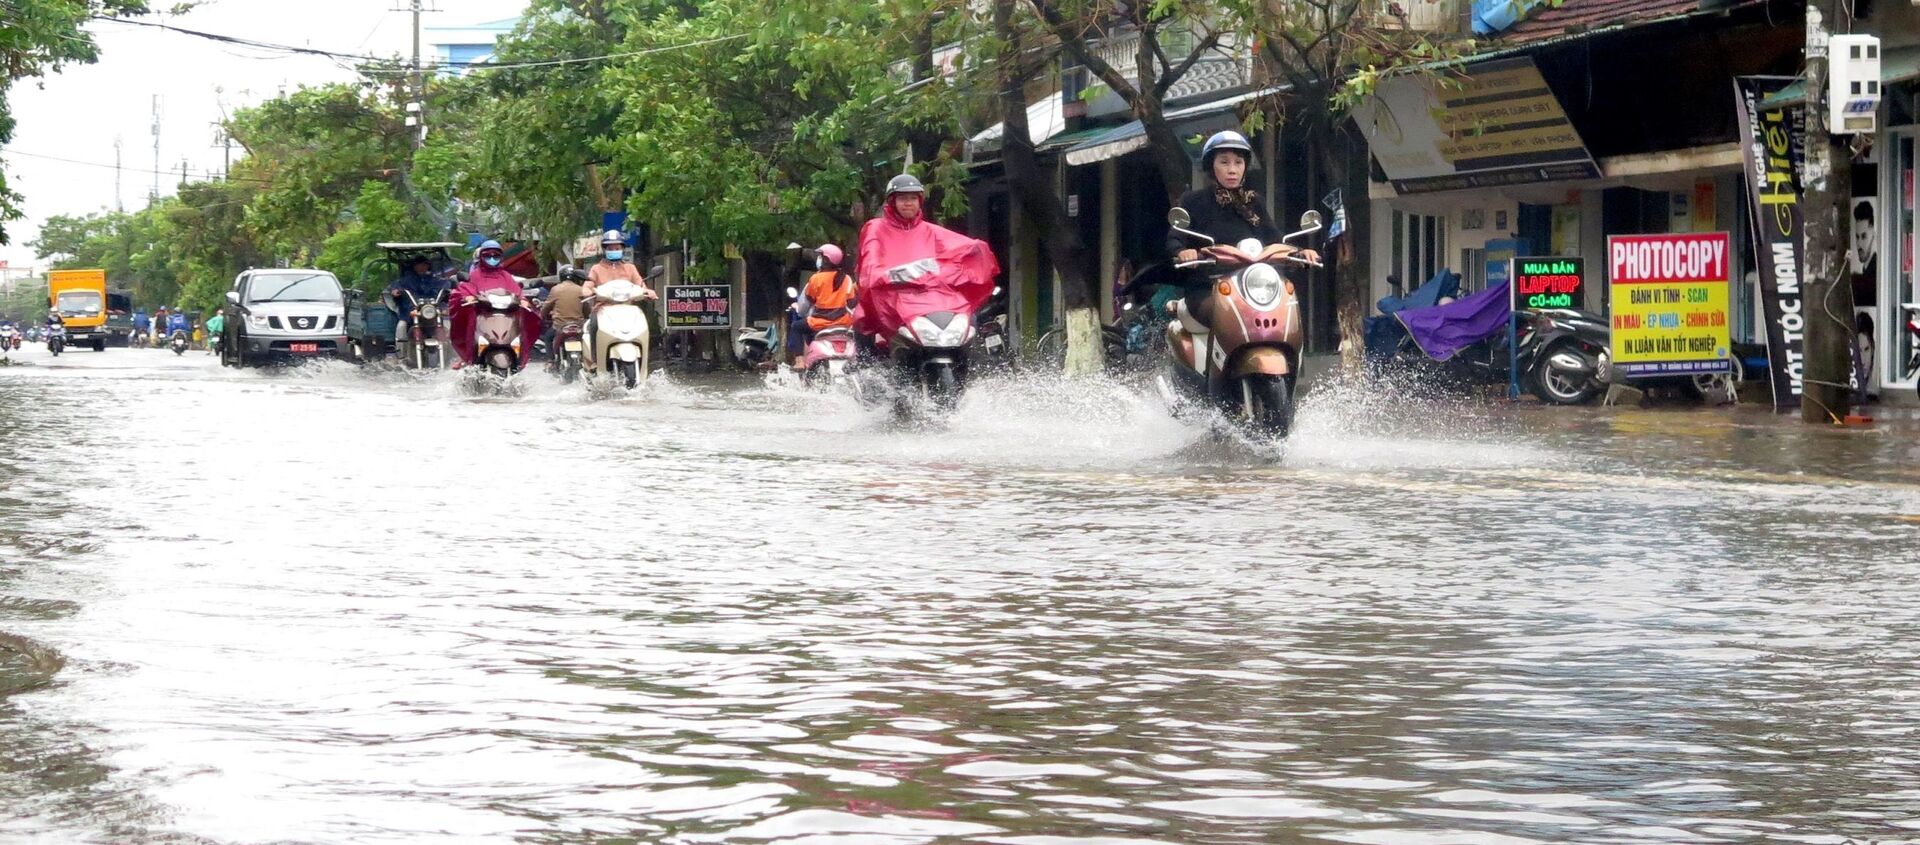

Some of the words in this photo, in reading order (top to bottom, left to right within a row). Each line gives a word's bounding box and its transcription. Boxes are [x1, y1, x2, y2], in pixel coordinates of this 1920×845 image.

[1524, 263, 1549, 274] MUA
[1552, 261, 1575, 274] BÁN
[1613, 239, 1726, 280] PHOTOCOPY
[1771, 242, 1800, 294] NAM
[674, 288, 701, 297] Salon
[703, 287, 721, 297] Tóc
[1519, 275, 1580, 293] LAPTOP
[1529, 293, 1571, 307] CŨ-MỚI
[1631, 286, 1652, 304] ĐÁNH
[1654, 290, 1661, 303] VI
[1664, 287, 1680, 303] TÍNH
[1687, 287, 1708, 302] SCAN
[668, 298, 703, 312] Hoàn
[706, 298, 728, 315] Mỹ
[1614, 315, 1622, 329] IN
[1623, 311, 1640, 329] MÀU
[1647, 309, 1657, 328] ÉP
[1659, 312, 1679, 331] NHỰA
[1777, 299, 1804, 343] TÓC
[1624, 340, 1633, 354] IN
[1635, 336, 1655, 357] LUẬN
[1674, 332, 1687, 352] TỐT
[1689, 334, 1717, 356] NGHIỆP
